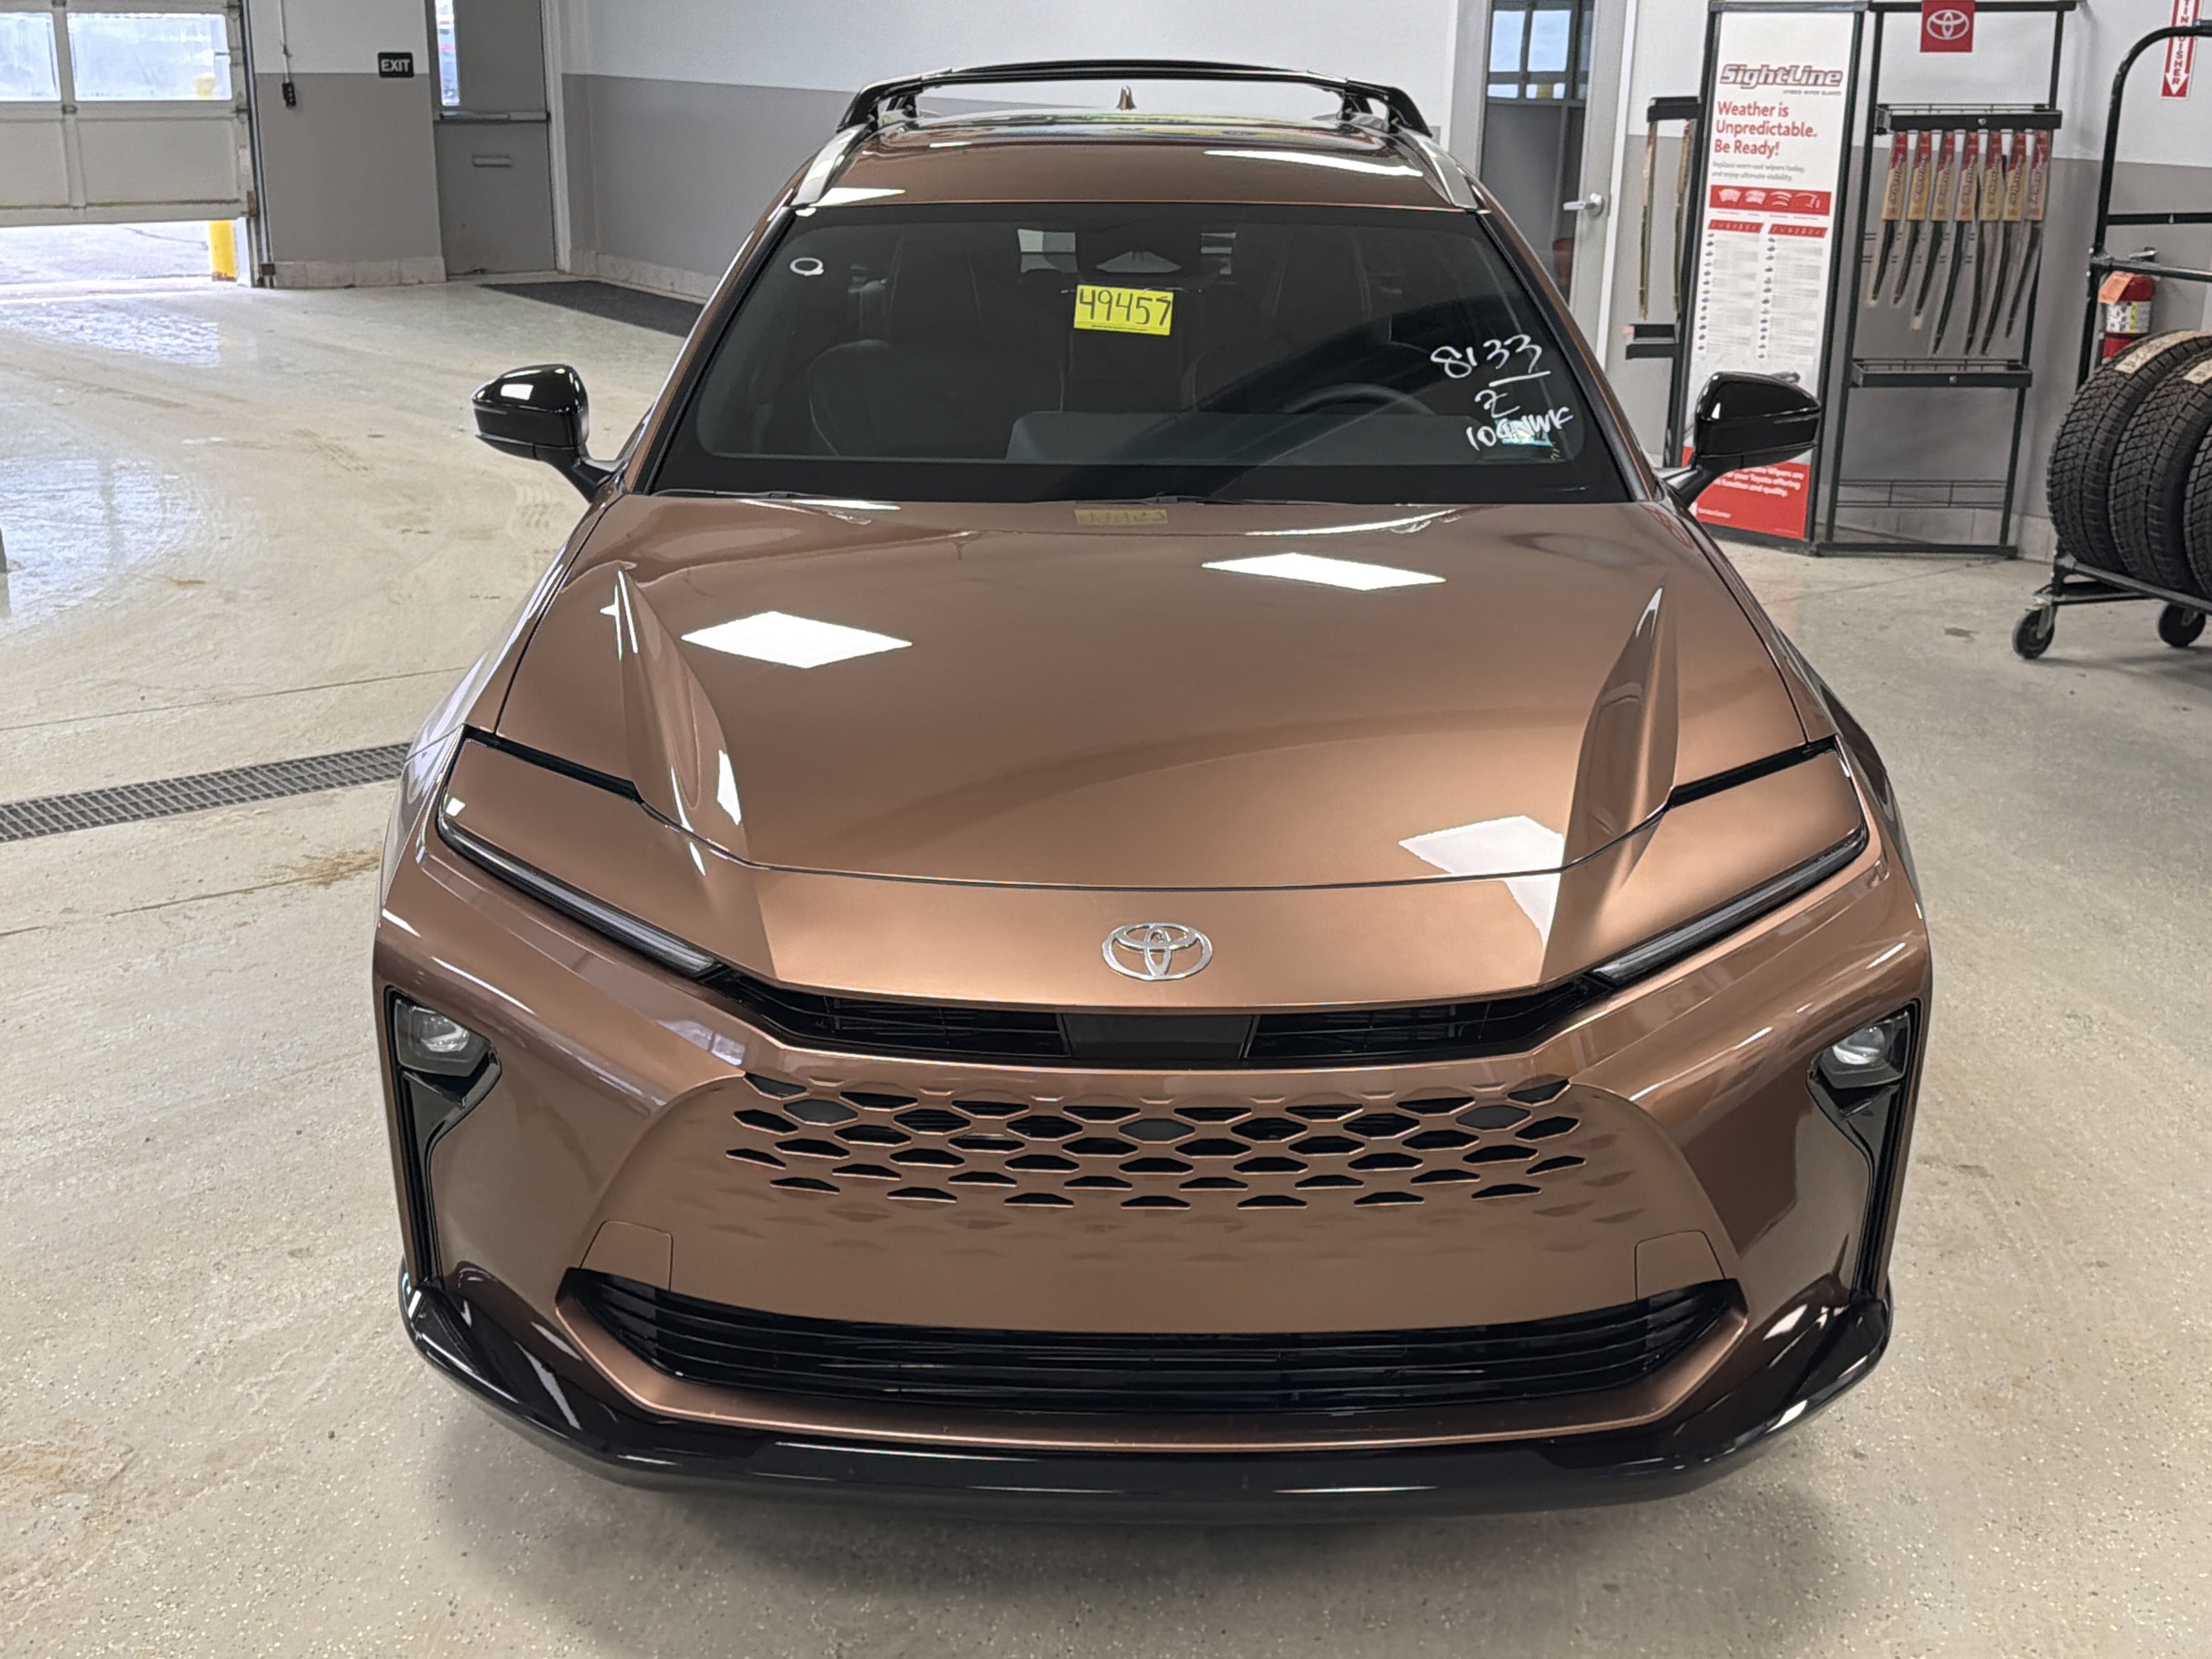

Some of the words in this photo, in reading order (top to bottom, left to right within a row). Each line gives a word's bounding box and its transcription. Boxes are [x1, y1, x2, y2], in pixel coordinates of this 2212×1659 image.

[381, 58, 410, 72] EXIT
[1719, 64, 1843, 89] SightLine
[1717, 101, 1776, 117] Weather
[1778, 102, 1790, 118] is
[1716, 119, 1818, 138] Unpredictable.
[1714, 139, 1730, 154] Be
[1734, 139, 1780, 160] Ready!
[1079, 288, 1172, 326] 49457
[1430, 334, 1543, 379] 8133
